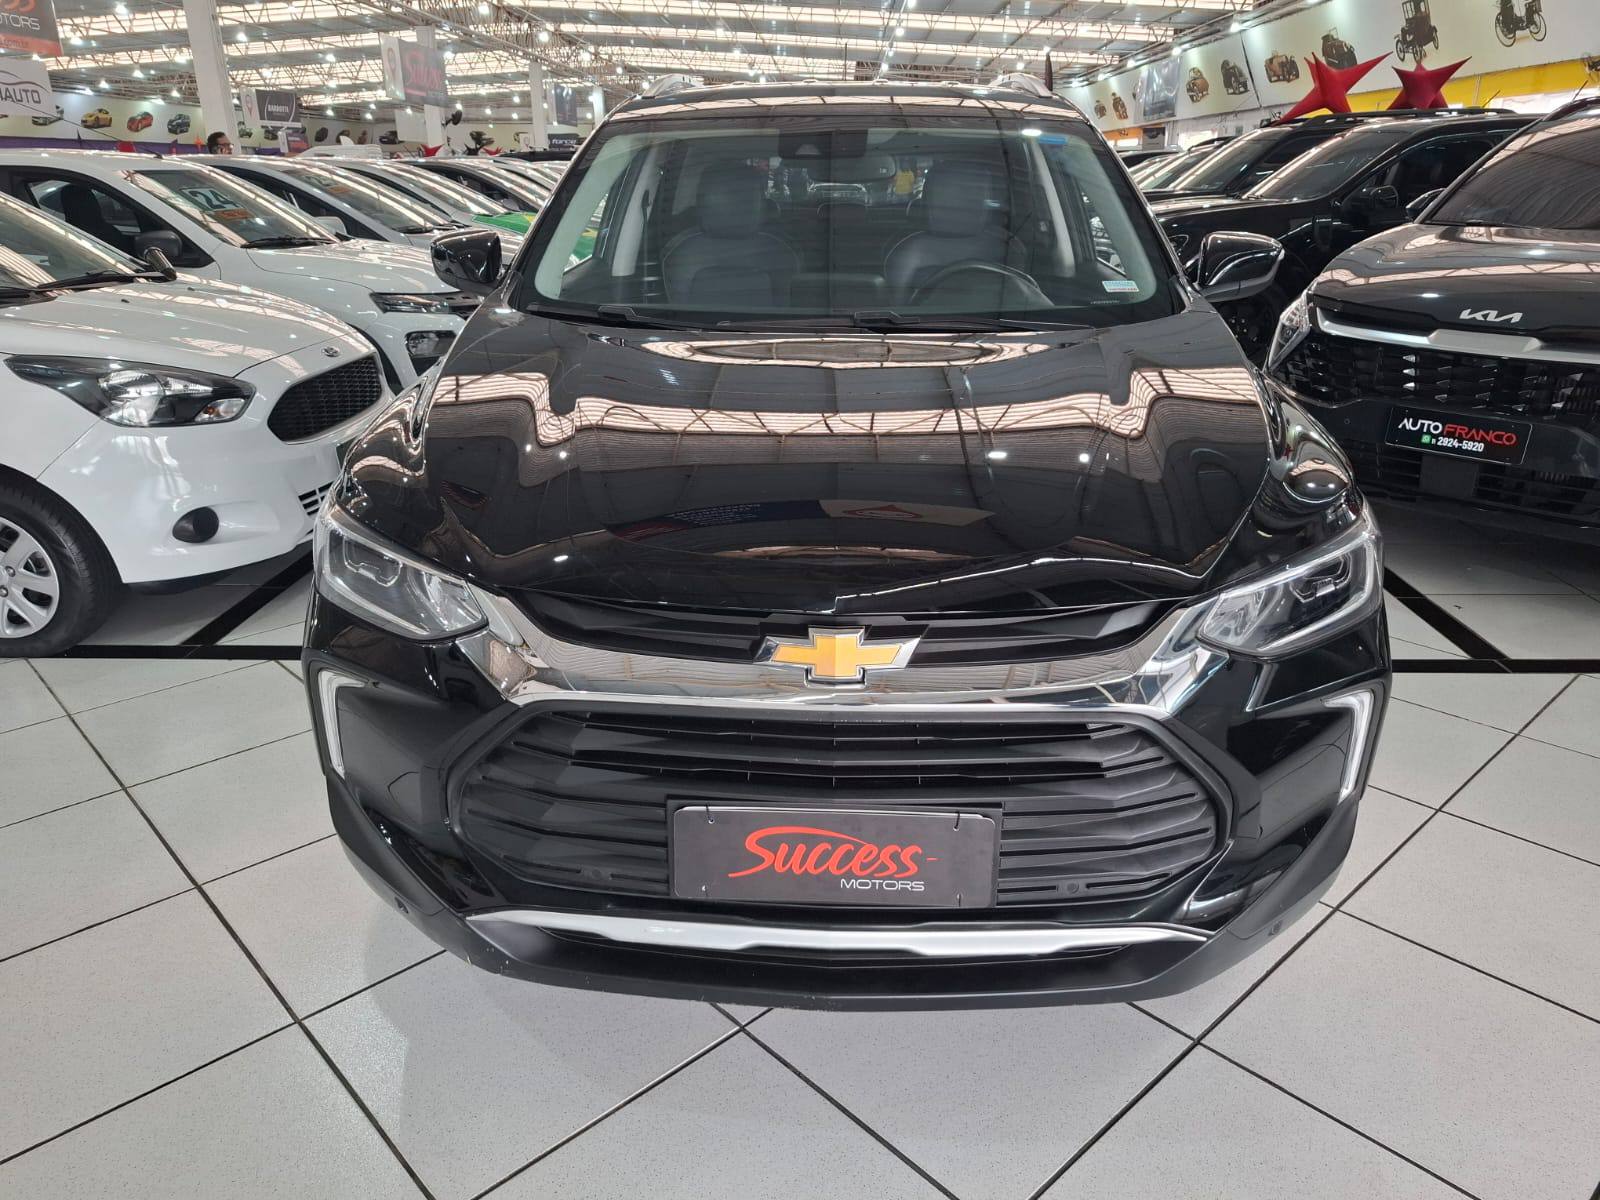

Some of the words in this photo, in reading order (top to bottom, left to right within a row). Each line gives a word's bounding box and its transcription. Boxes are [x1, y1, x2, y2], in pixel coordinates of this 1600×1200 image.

[0, 12, 41, 31] TORS
[188, 190, 240, 209] 24
[1459, 308, 1523, 323] KIA
[1437, 436, 1485, 452] 2924-5920
[728, 825, 922, 878] Success
[840, 878, 925, 892] MOTORS
